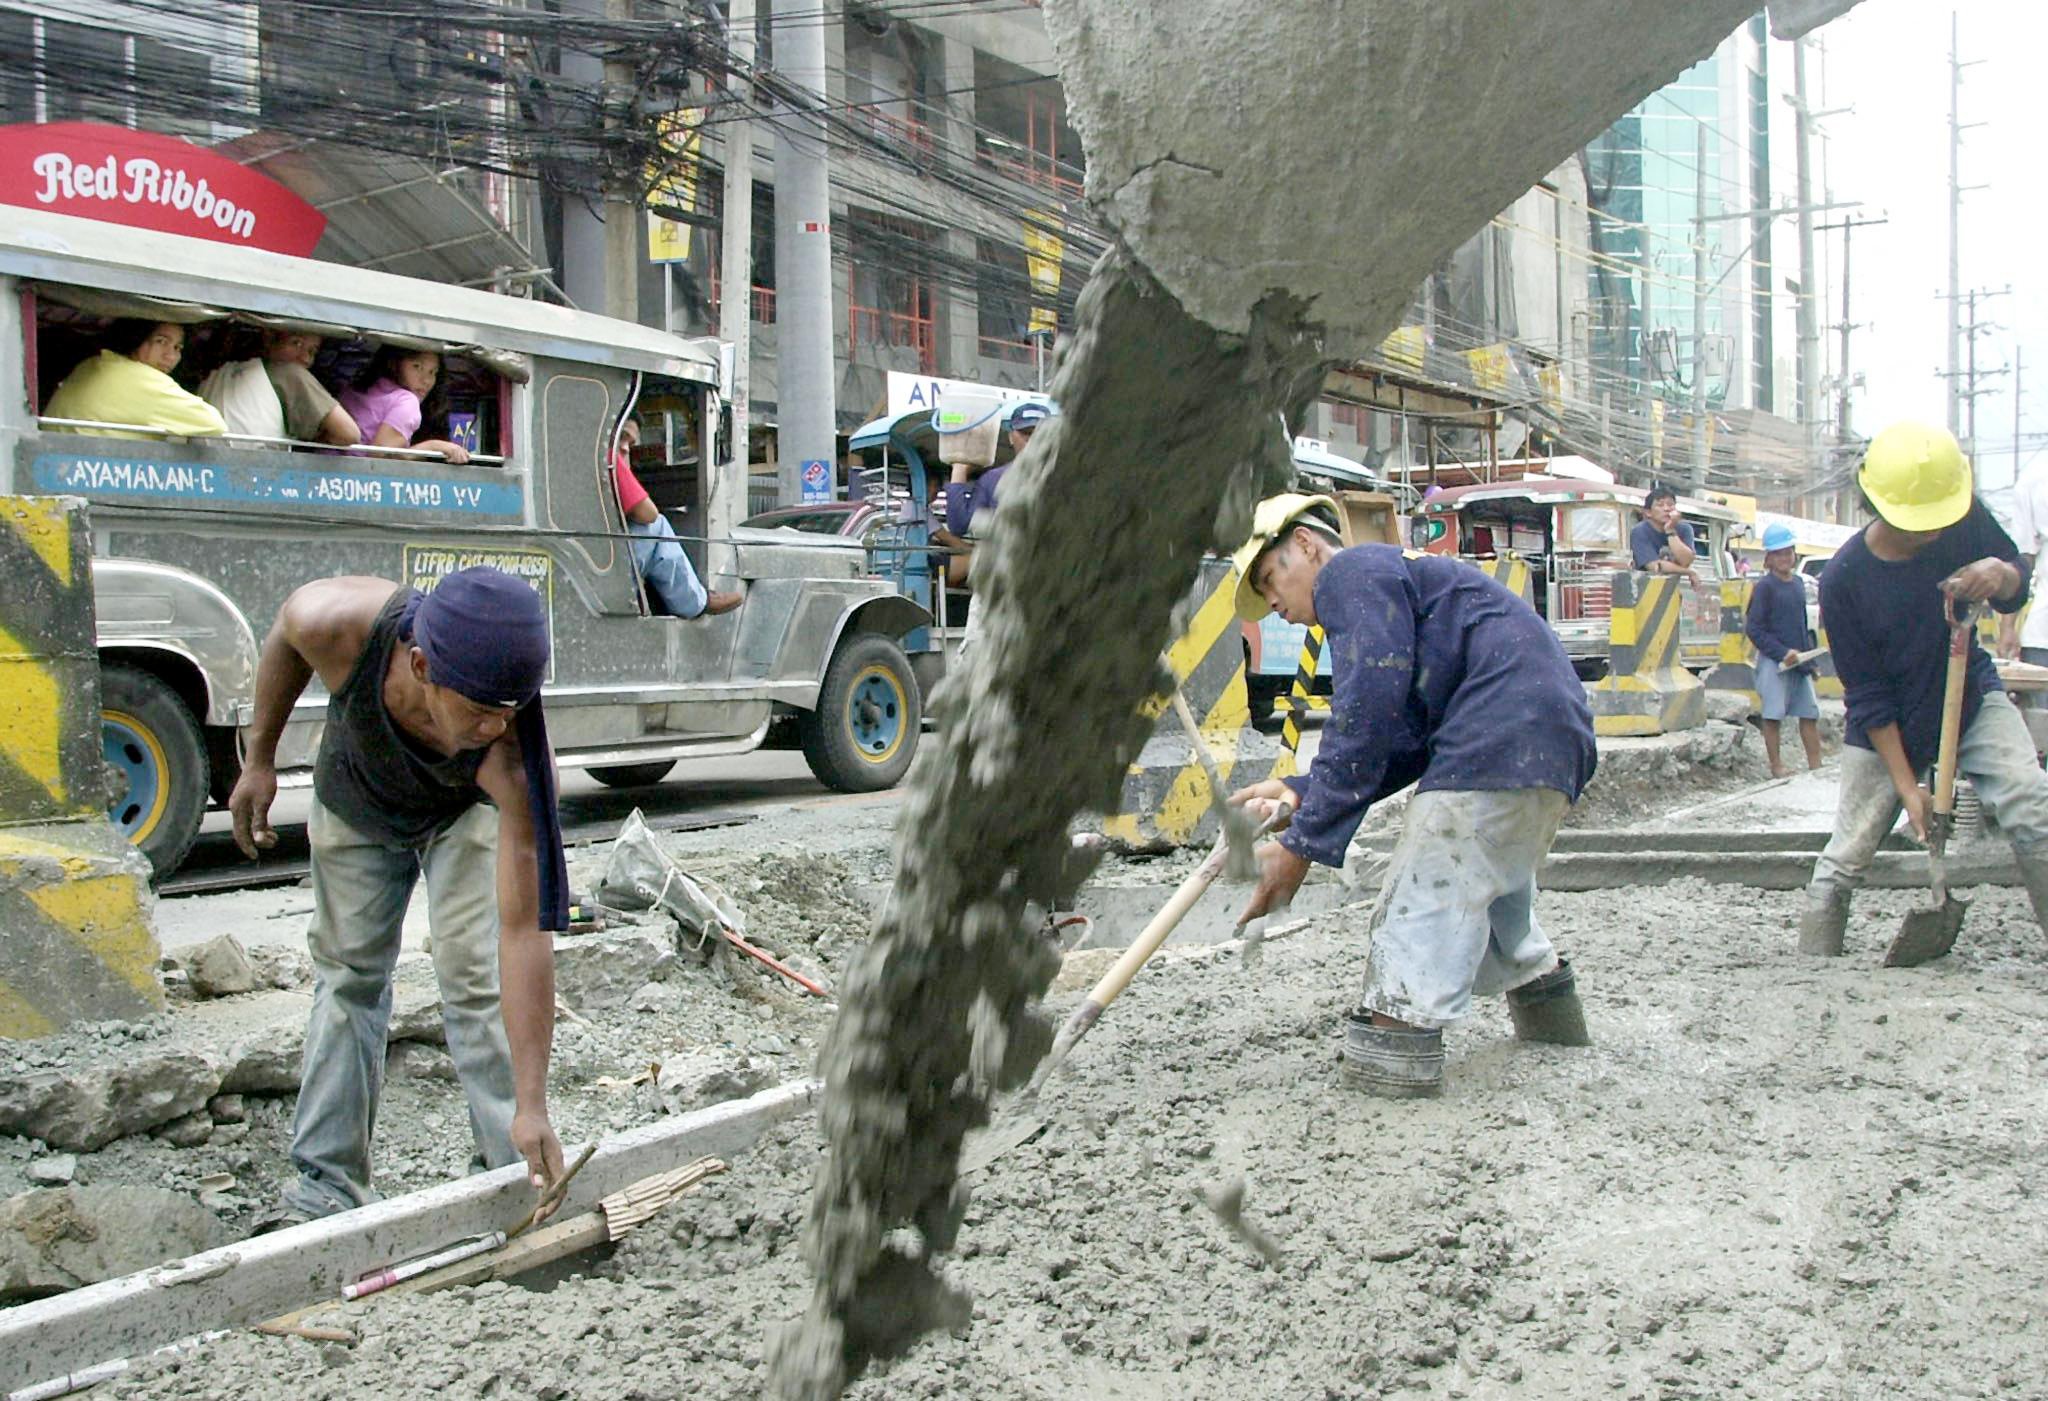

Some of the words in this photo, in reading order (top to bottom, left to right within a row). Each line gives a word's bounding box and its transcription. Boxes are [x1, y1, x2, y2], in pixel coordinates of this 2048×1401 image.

[33, 153, 118, 203] Red
[123, 158, 256, 238] Ribbon
[66, 460, 214, 493] AYAMANAN-C
[308, 477, 381, 502] ASONG
[414, 552, 456, 575] LTFRB
